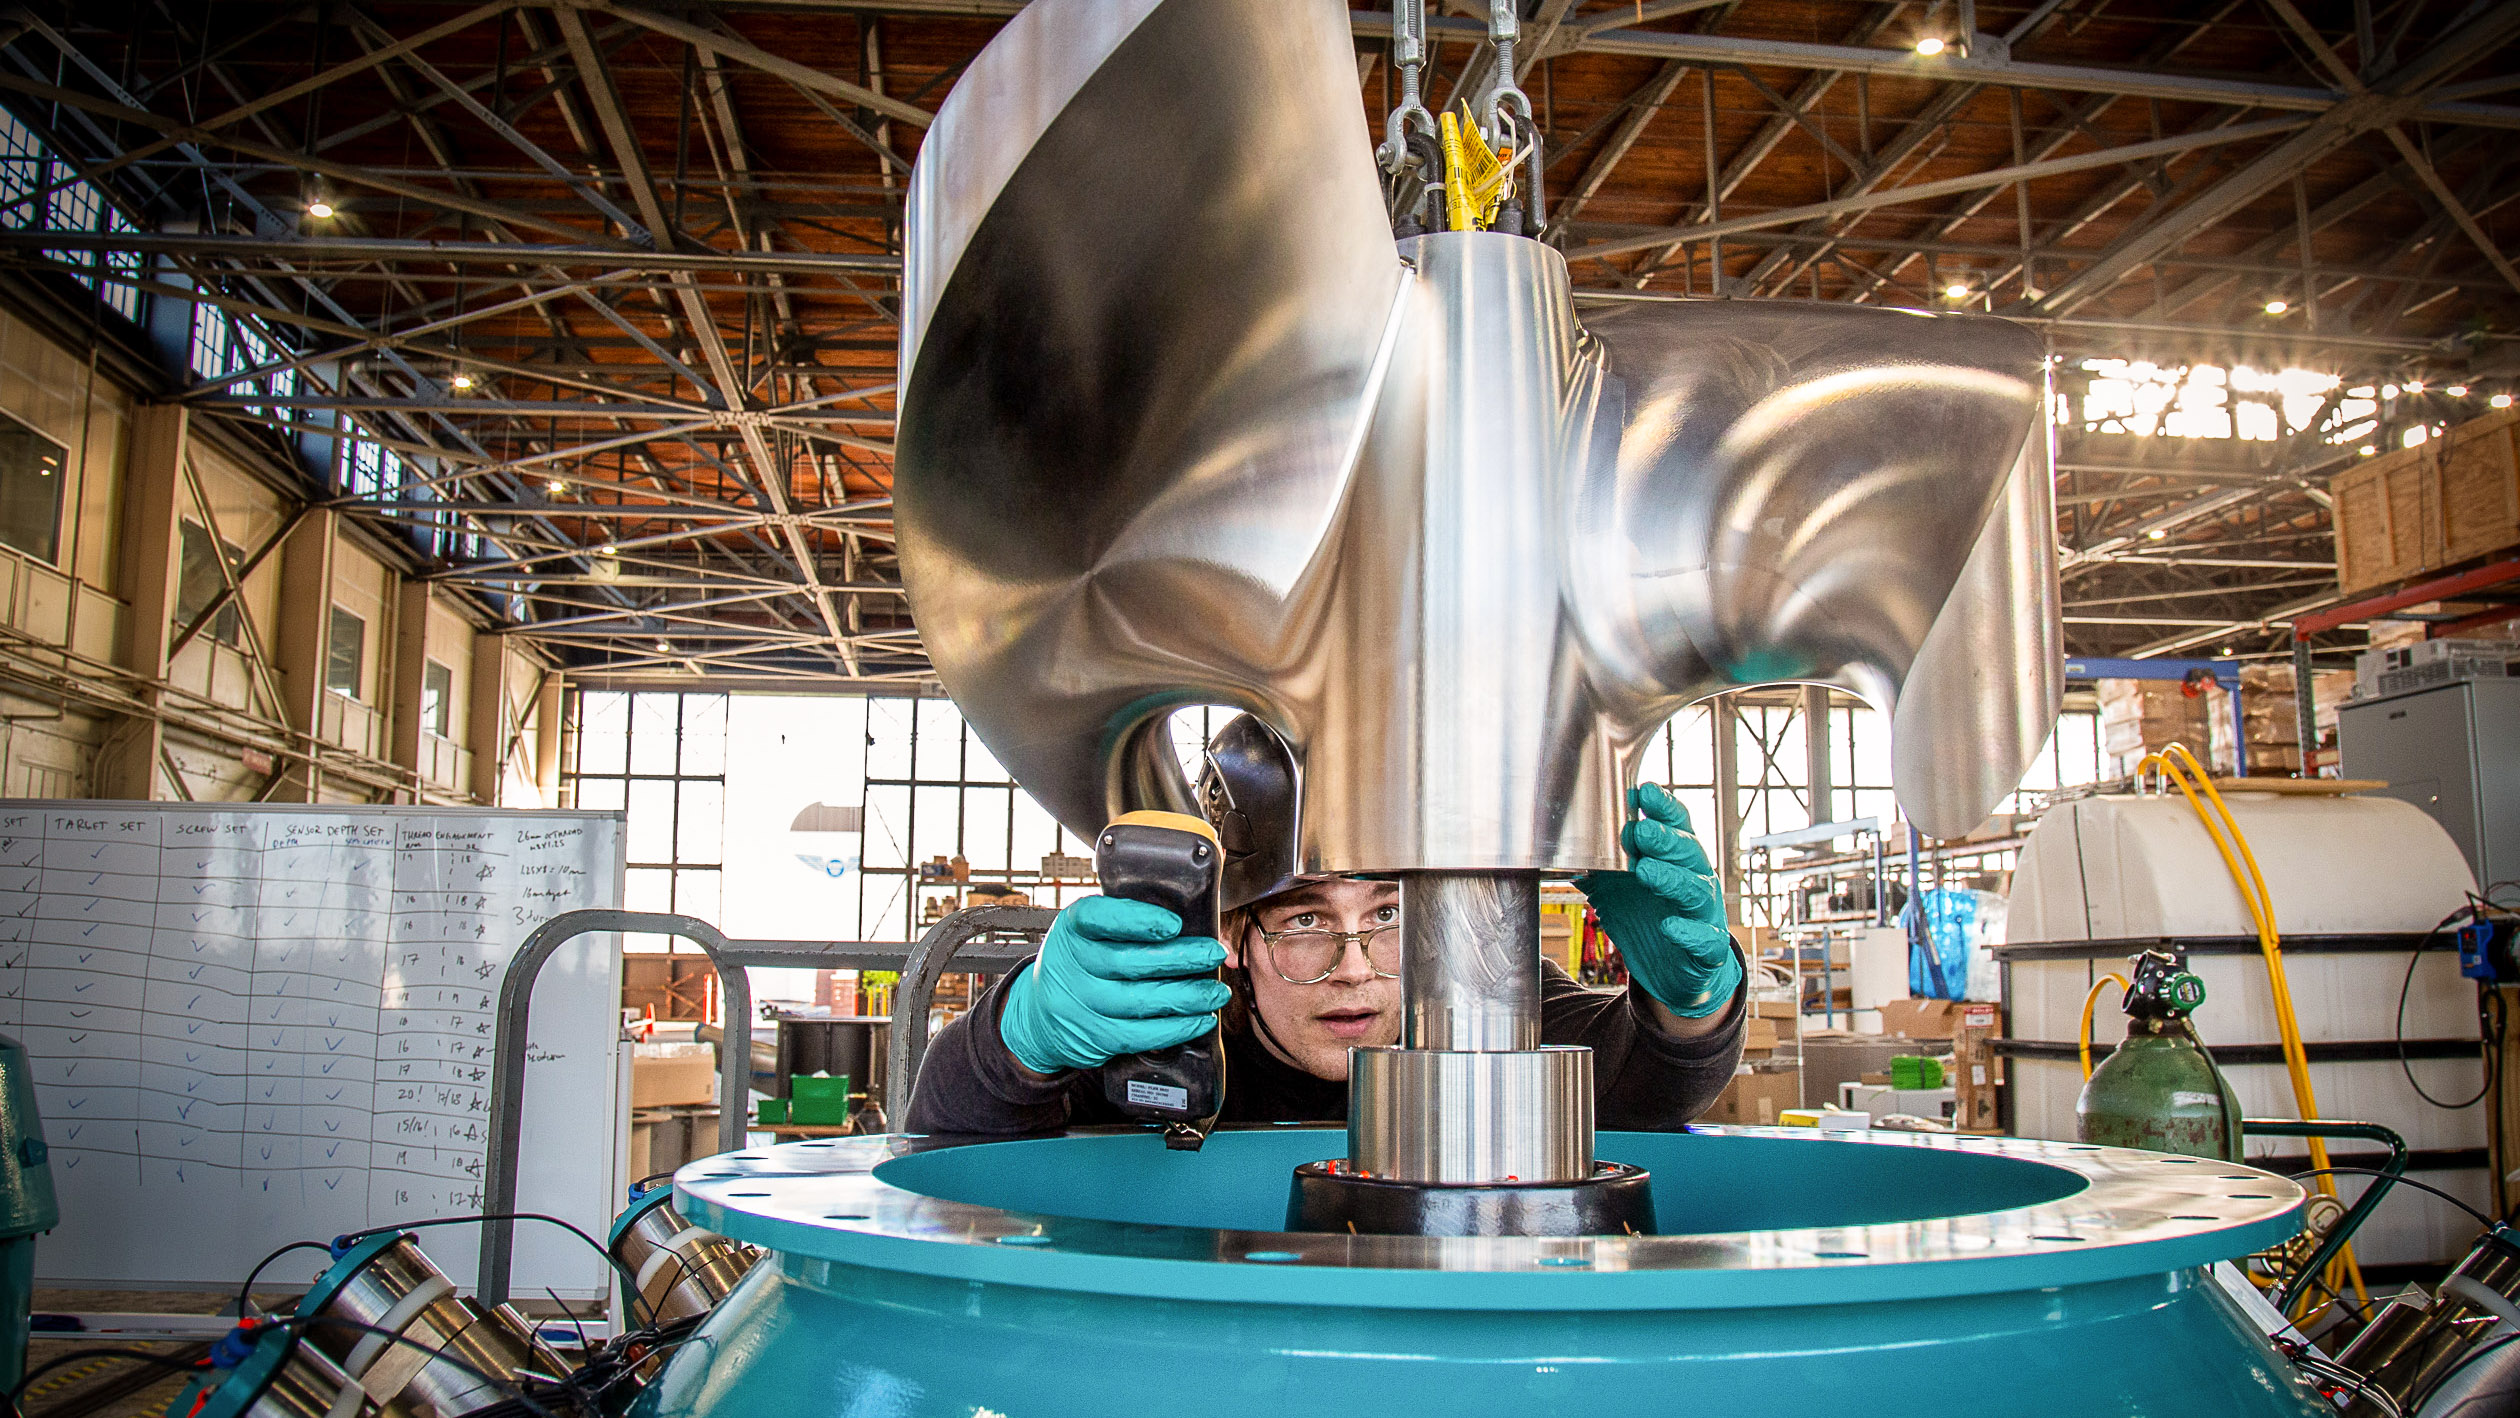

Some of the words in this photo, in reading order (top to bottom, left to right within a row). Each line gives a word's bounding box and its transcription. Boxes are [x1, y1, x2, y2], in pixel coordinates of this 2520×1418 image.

[120, 821, 147, 832] SET
[225, 825, 248, 835] SET
[285, 824, 322, 837] SENSOR
[327, 824, 359, 836] DEPTH
[363, 824, 385, 837] SET
[512, 906, 525, 926] 3
[401, 953, 420, 967] 17
[398, 1039, 410, 1054] 16
[450, 1040, 466, 1055] 17
[398, 1064, 411, 1077] 17
[452, 1065, 463, 1079] 18
[395, 1189, 409, 1207] 18
